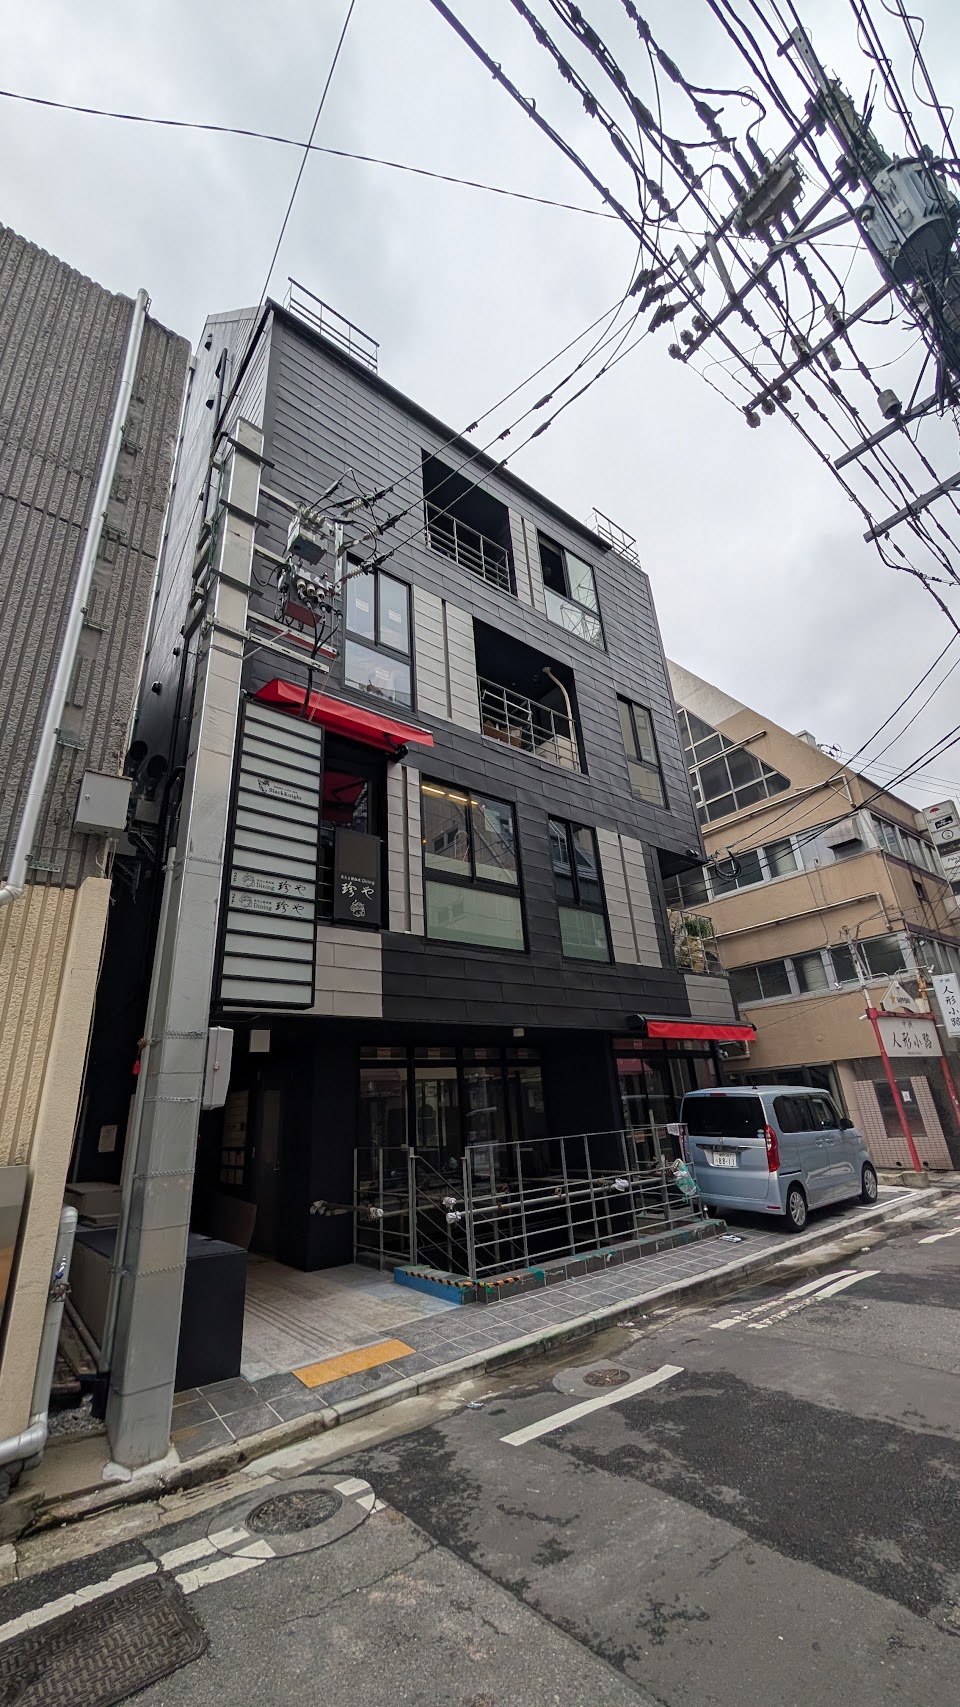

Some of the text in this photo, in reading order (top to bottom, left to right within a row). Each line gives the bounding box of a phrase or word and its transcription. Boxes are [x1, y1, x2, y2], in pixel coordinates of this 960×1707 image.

[256, 882, 275, 891] Dining
[278, 880, 307, 896] 珍や
[341, 881, 375, 901] 珍や
[253, 902, 272, 911] Dining
[275, 900, 305, 916] 珍や
[892, 1031, 933, 1049] 人形小路
